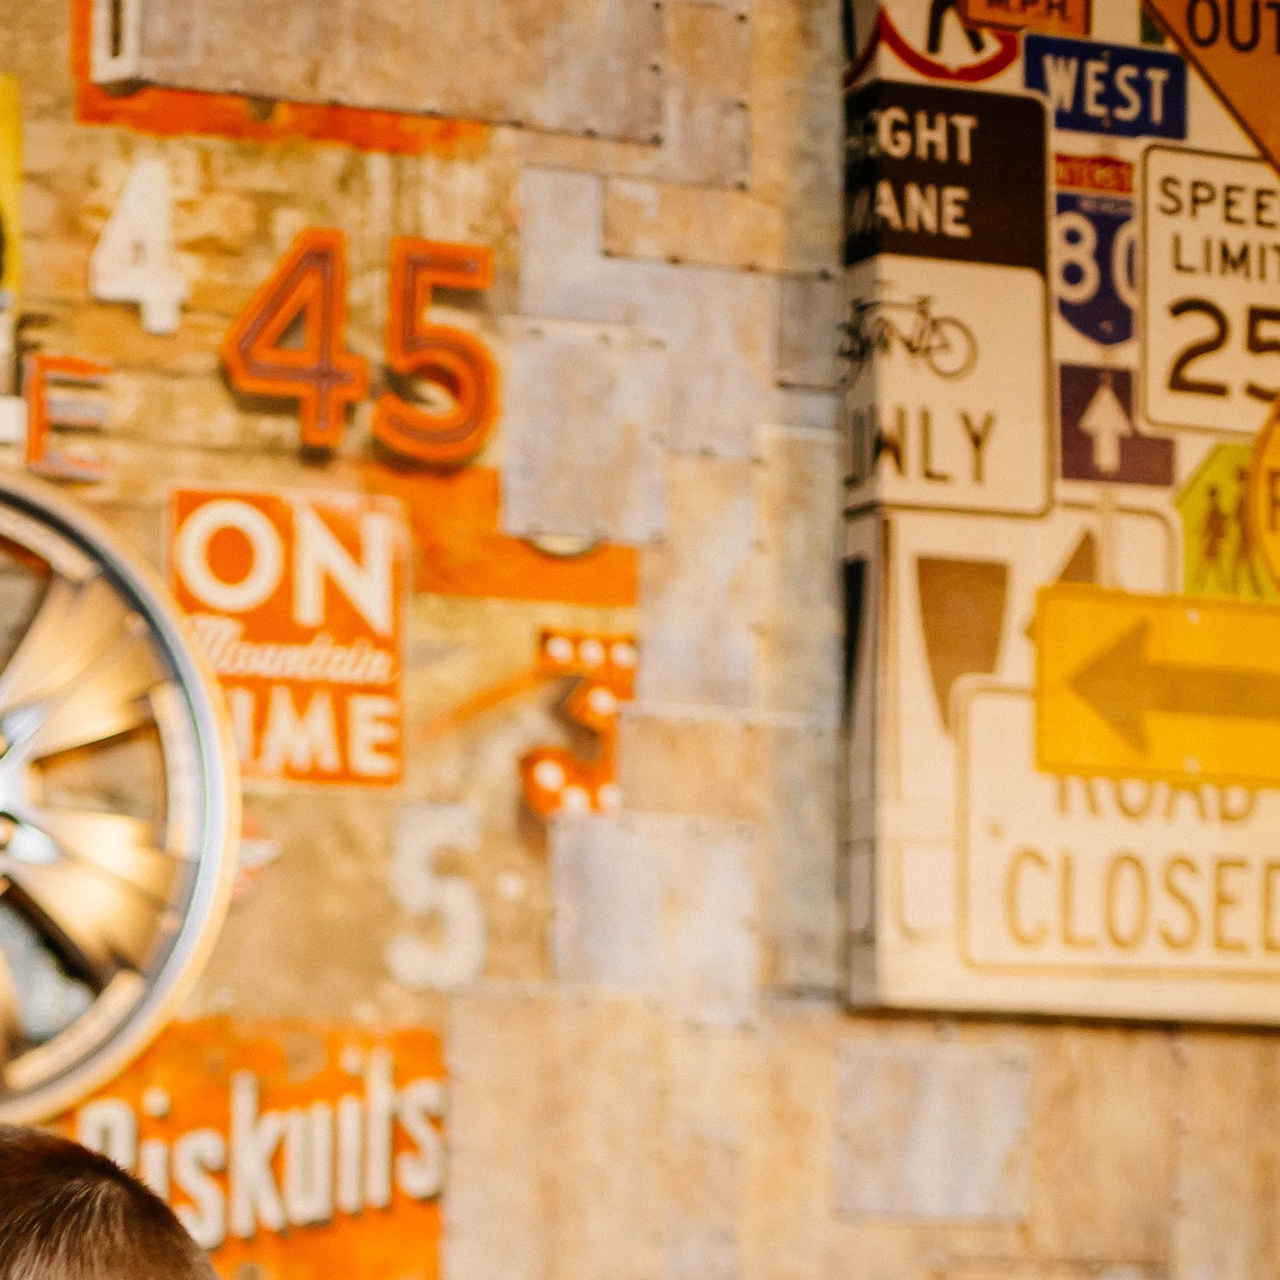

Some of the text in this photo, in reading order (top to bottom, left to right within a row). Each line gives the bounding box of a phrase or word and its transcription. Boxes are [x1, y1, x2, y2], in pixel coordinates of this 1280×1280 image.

[1042, 52, 1170, 126] WEST
[870, 105, 979, 166] GHT
[870, 178, 973, 240] ANE
[1173, 234, 1280, 282] LIMI
[223, 228, 500, 468] 45
[175, 497, 397, 640] ON
[228, 683, 404, 780] IME
